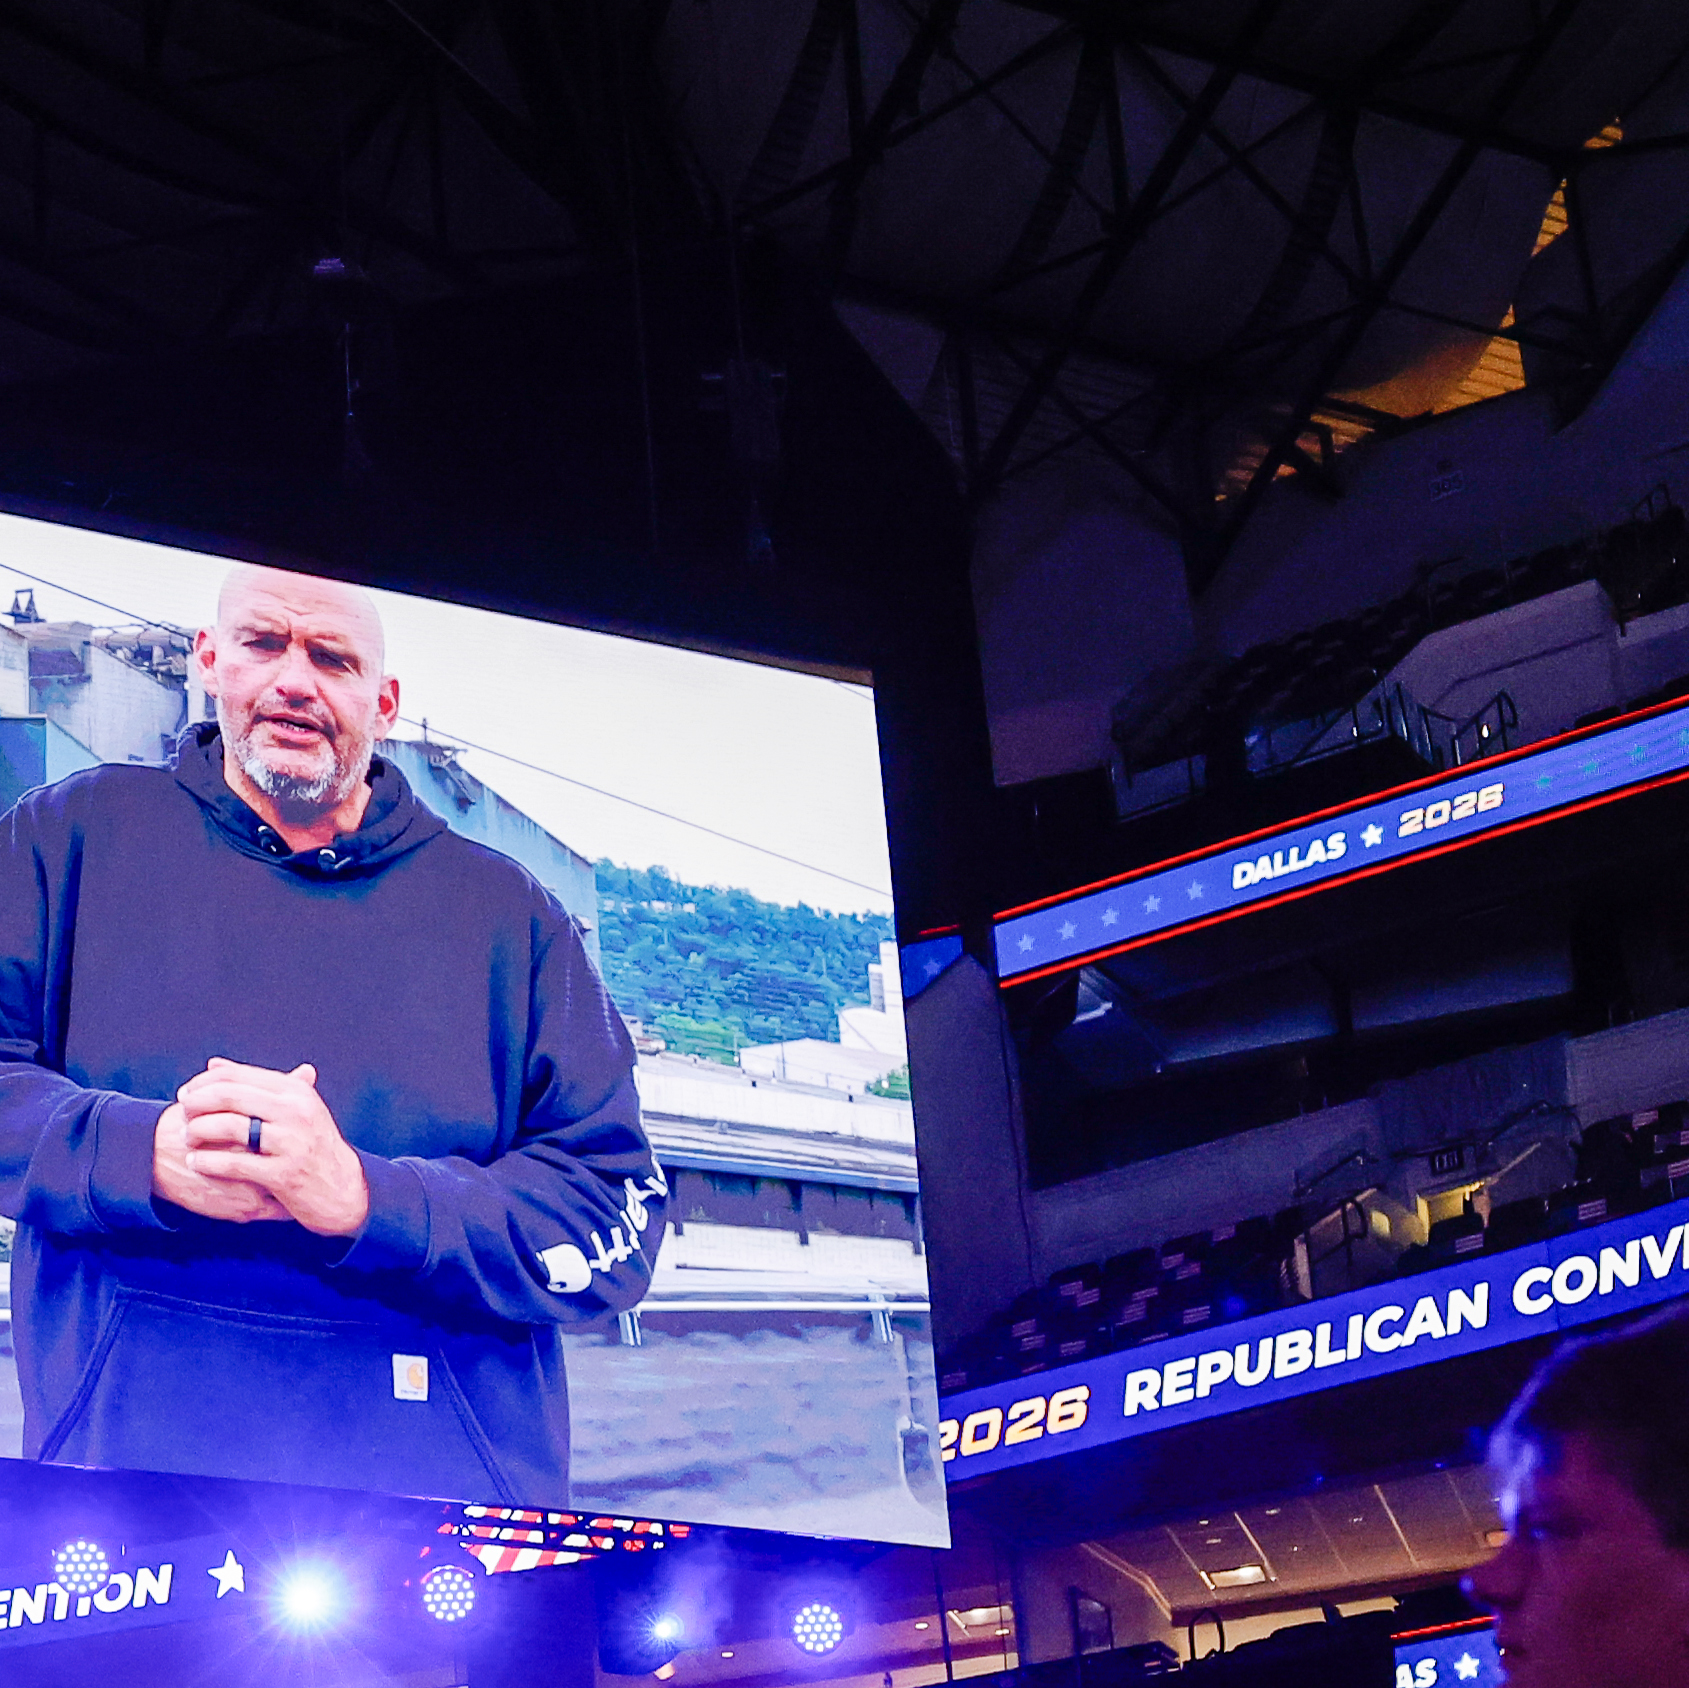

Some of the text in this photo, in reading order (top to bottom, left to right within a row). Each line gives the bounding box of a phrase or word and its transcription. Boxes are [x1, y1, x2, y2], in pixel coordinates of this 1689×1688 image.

[1231, 783, 1505, 890] DALLAS 2026
[938, 1384, 1091, 1462] 2026
[1122, 1282, 1489, 1417] REPUBLICAN
